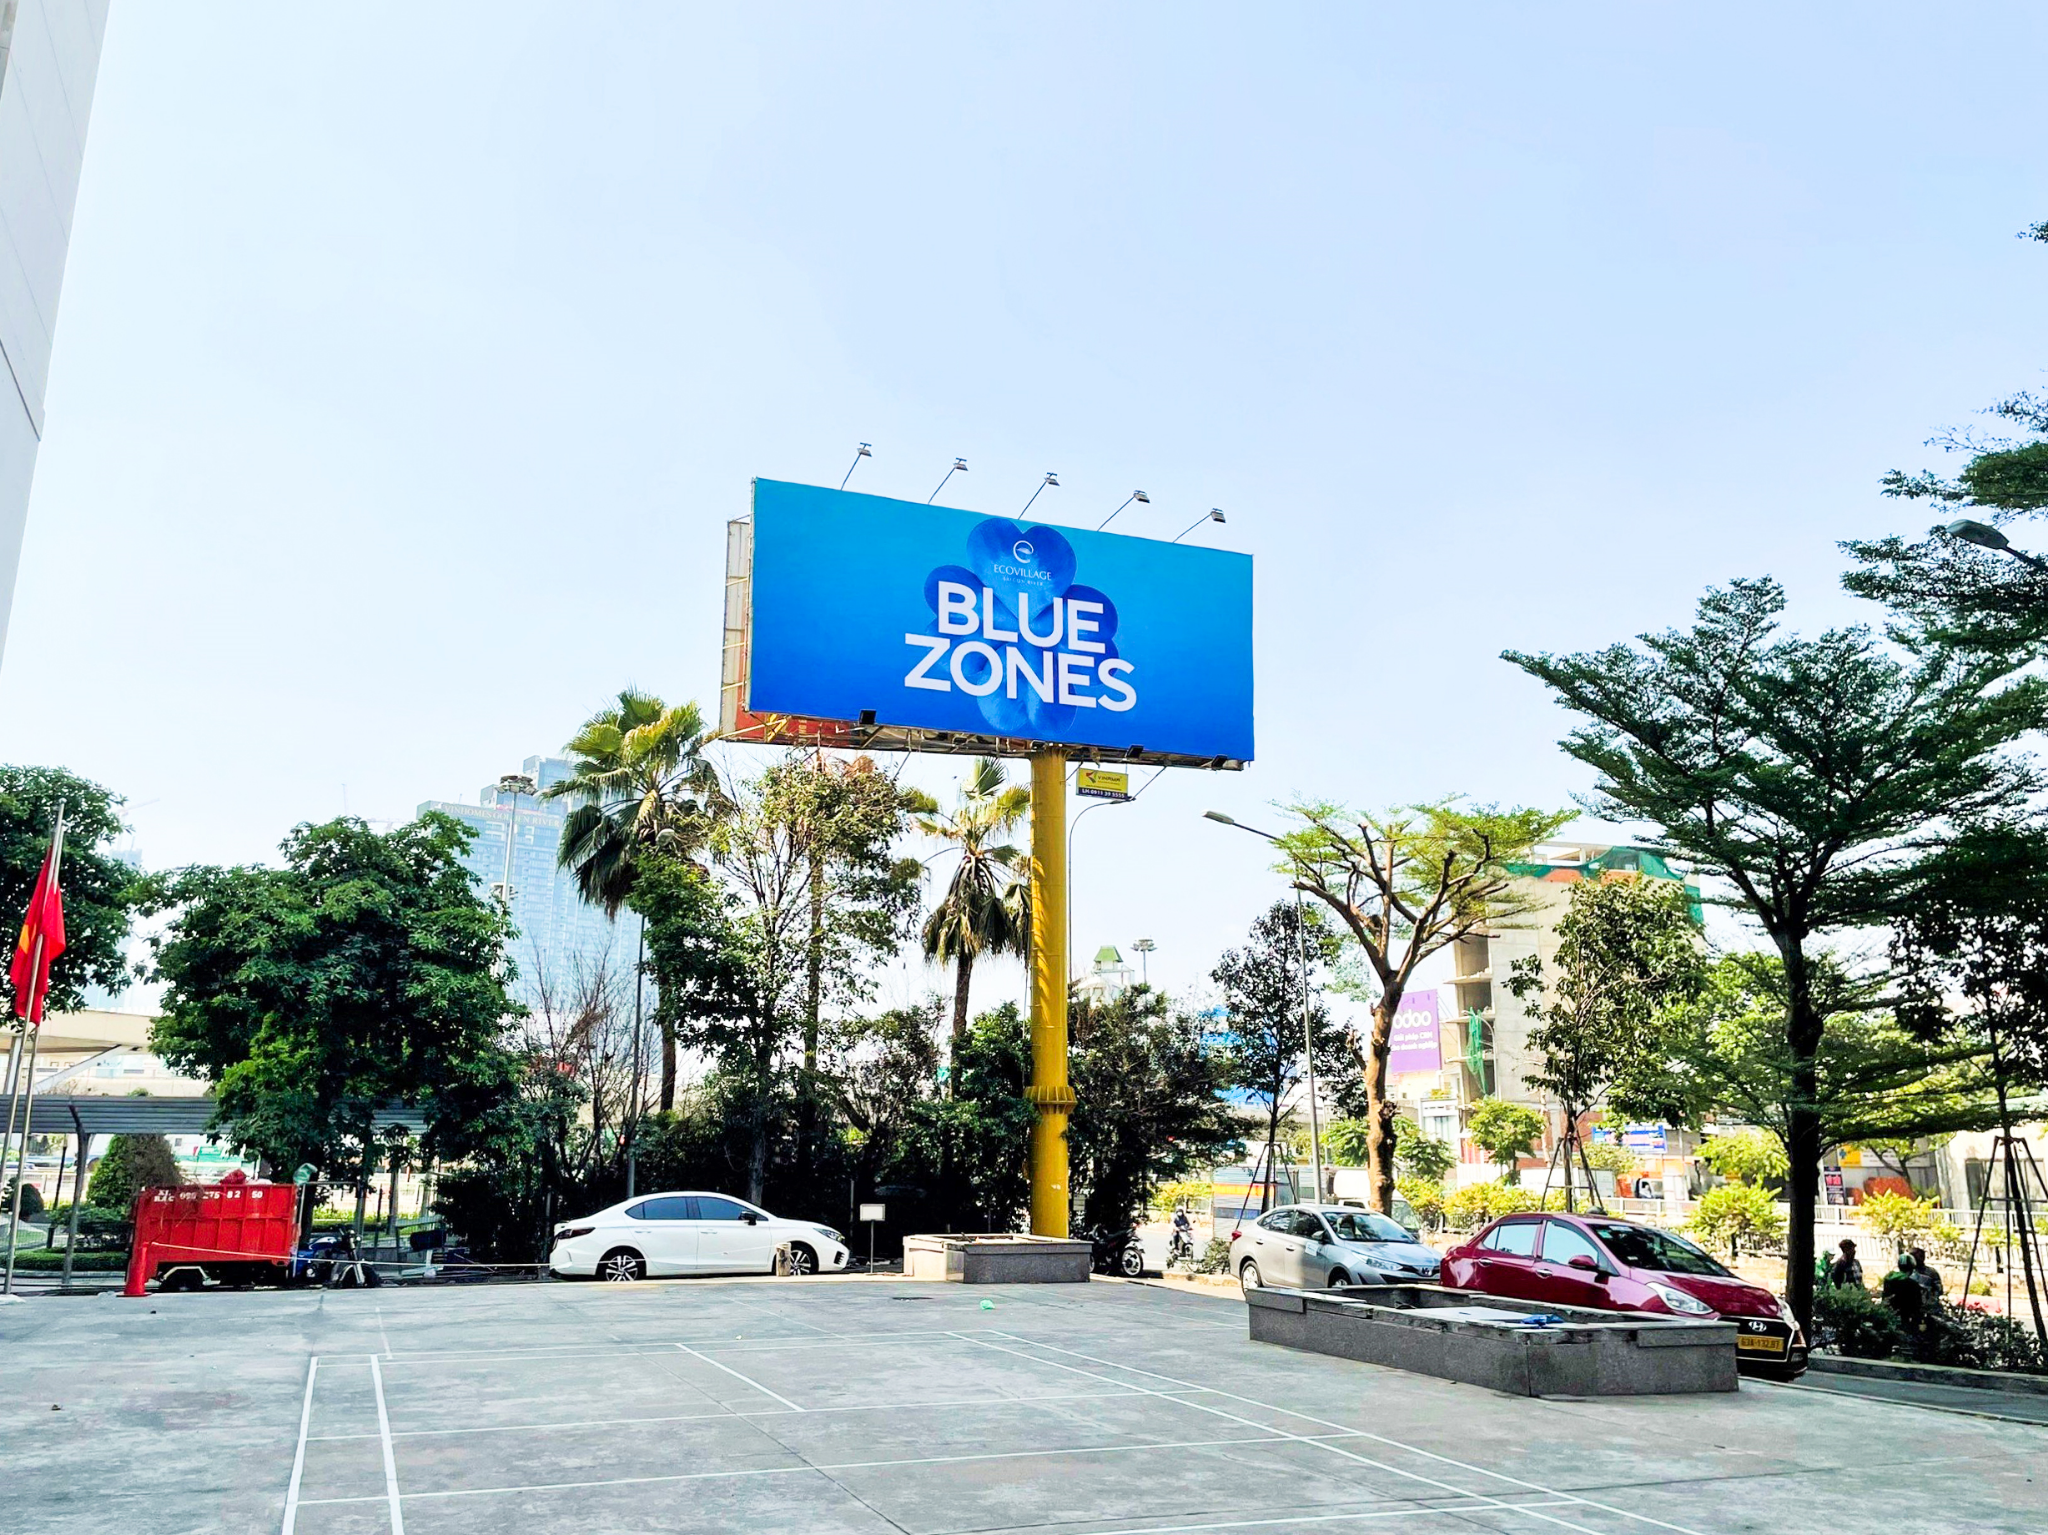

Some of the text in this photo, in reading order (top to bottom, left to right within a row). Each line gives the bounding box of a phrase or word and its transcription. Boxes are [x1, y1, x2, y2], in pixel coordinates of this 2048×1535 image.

[993, 564, 1052, 581] ECOVILLAGE
[938, 581, 1106, 654] BLUE
[904, 633, 1137, 712] ZONES
[444, 805, 492, 818] VINHOMES
[532, 816, 560, 827] RIVER
[1393, 1008, 1432, 1030] odoo
[251, 1190, 263, 1199] 50
